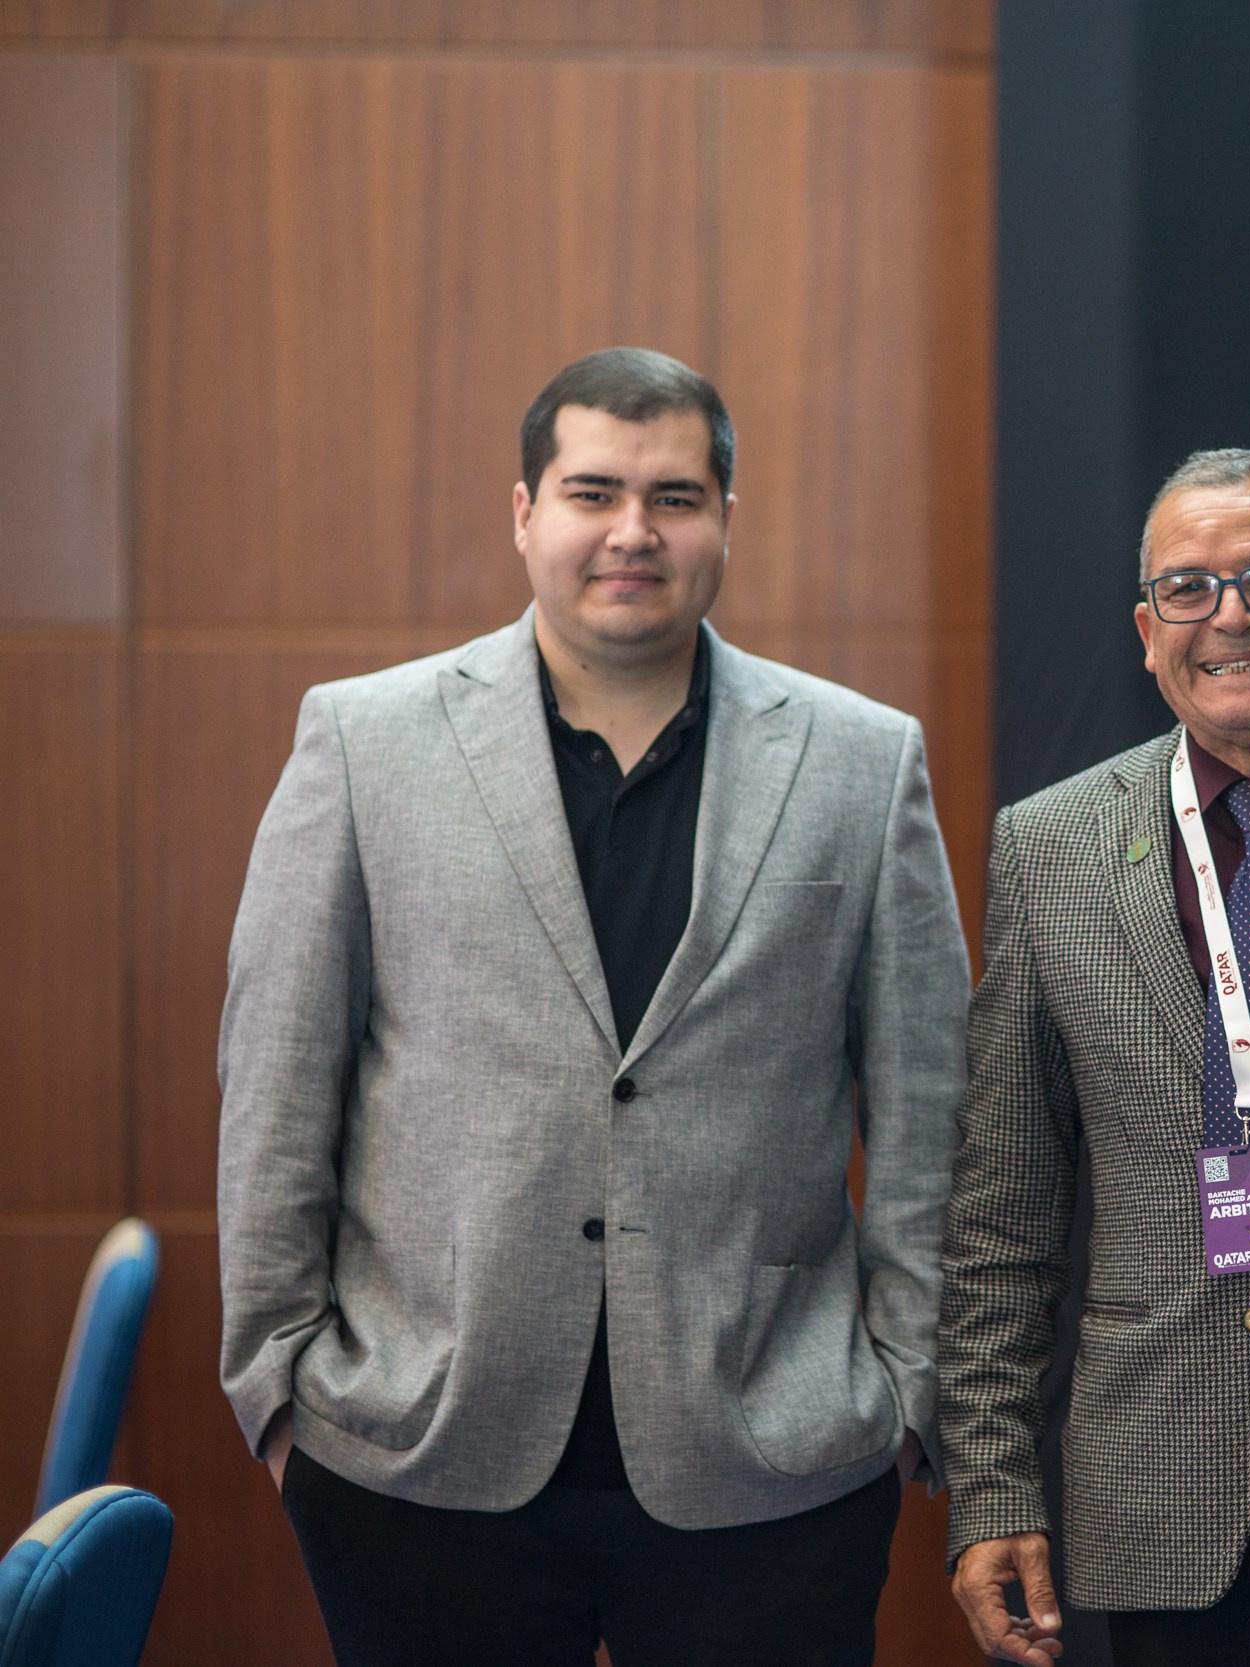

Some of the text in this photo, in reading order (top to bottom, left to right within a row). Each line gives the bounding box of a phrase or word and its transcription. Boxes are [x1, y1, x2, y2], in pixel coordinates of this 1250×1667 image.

[1216, 951, 1237, 995] QATAR
[1207, 1189, 1246, 1199] BAKTACHE
[1208, 1196, 1245, 1205] MOHAMED
